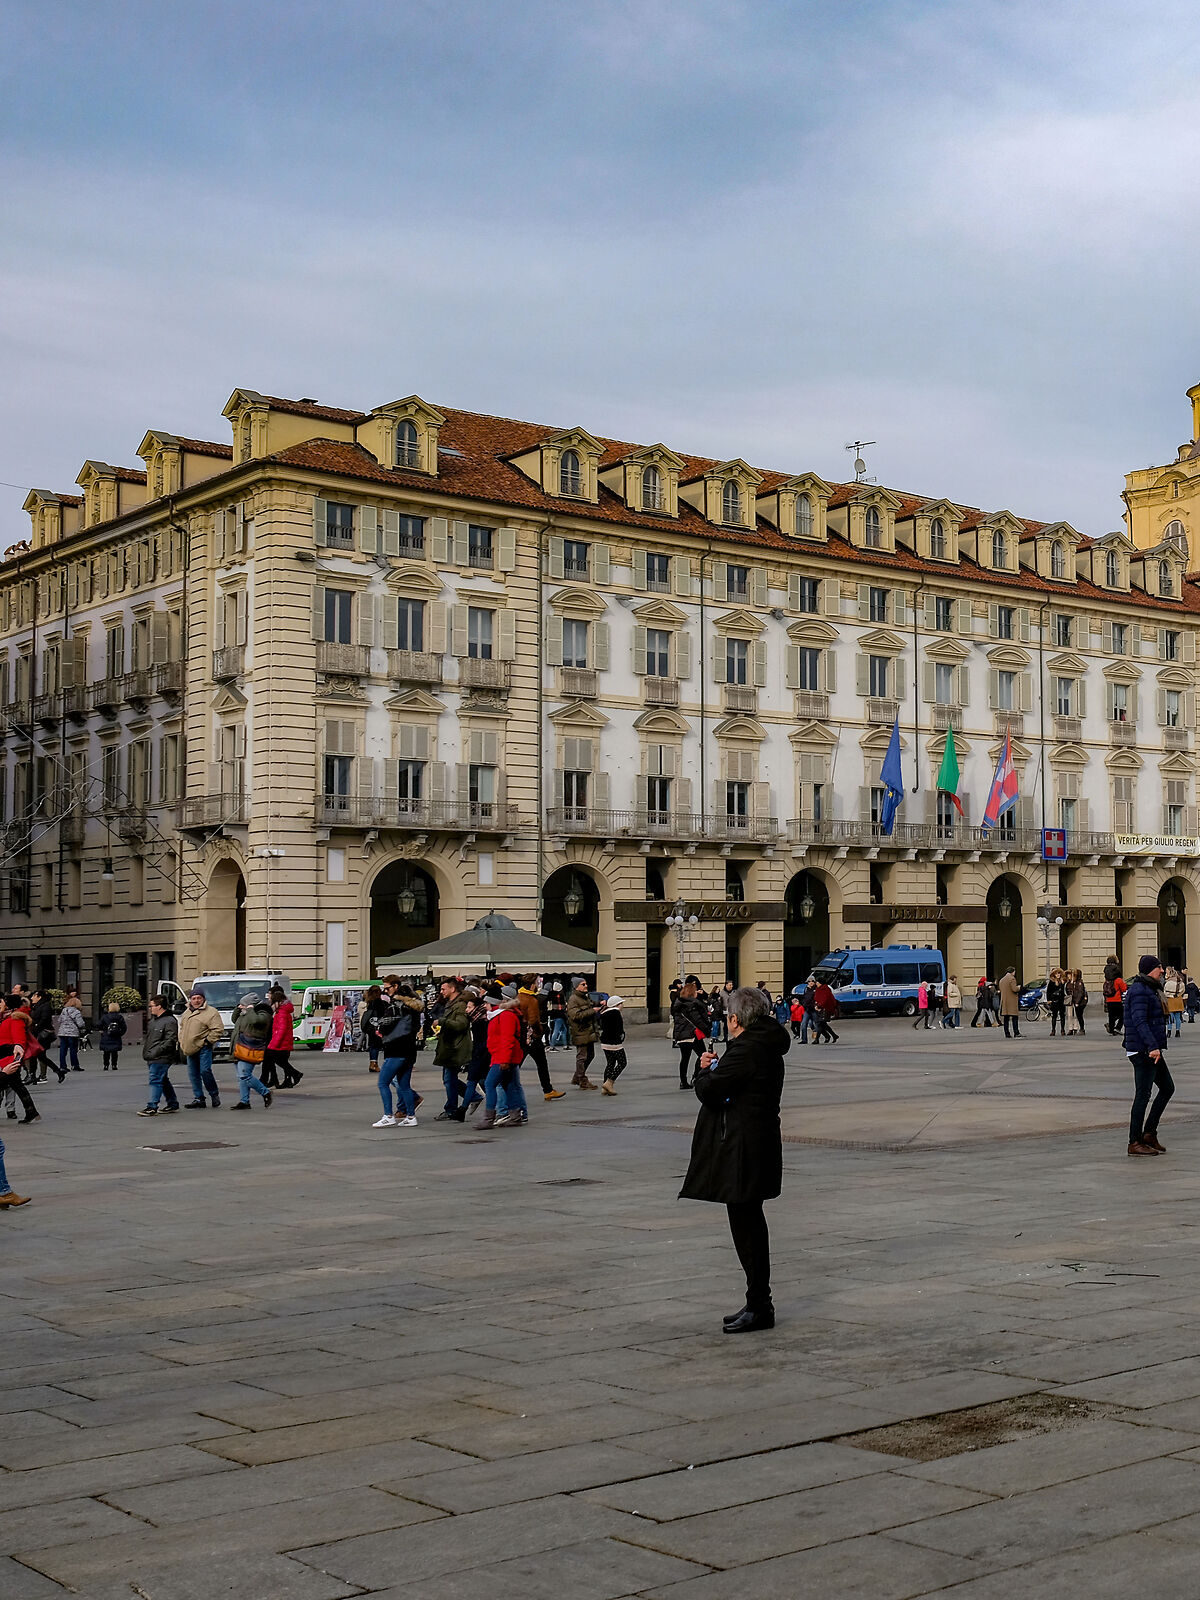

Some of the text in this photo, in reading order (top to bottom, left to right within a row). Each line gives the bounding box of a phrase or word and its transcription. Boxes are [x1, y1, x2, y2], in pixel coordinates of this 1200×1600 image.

[1142, 837, 1153, 846] PER
[1154, 837, 1174, 847] GIULIO
[889, 907, 945, 920] DELLA
[1065, 908, 1137, 920] REGIONE
